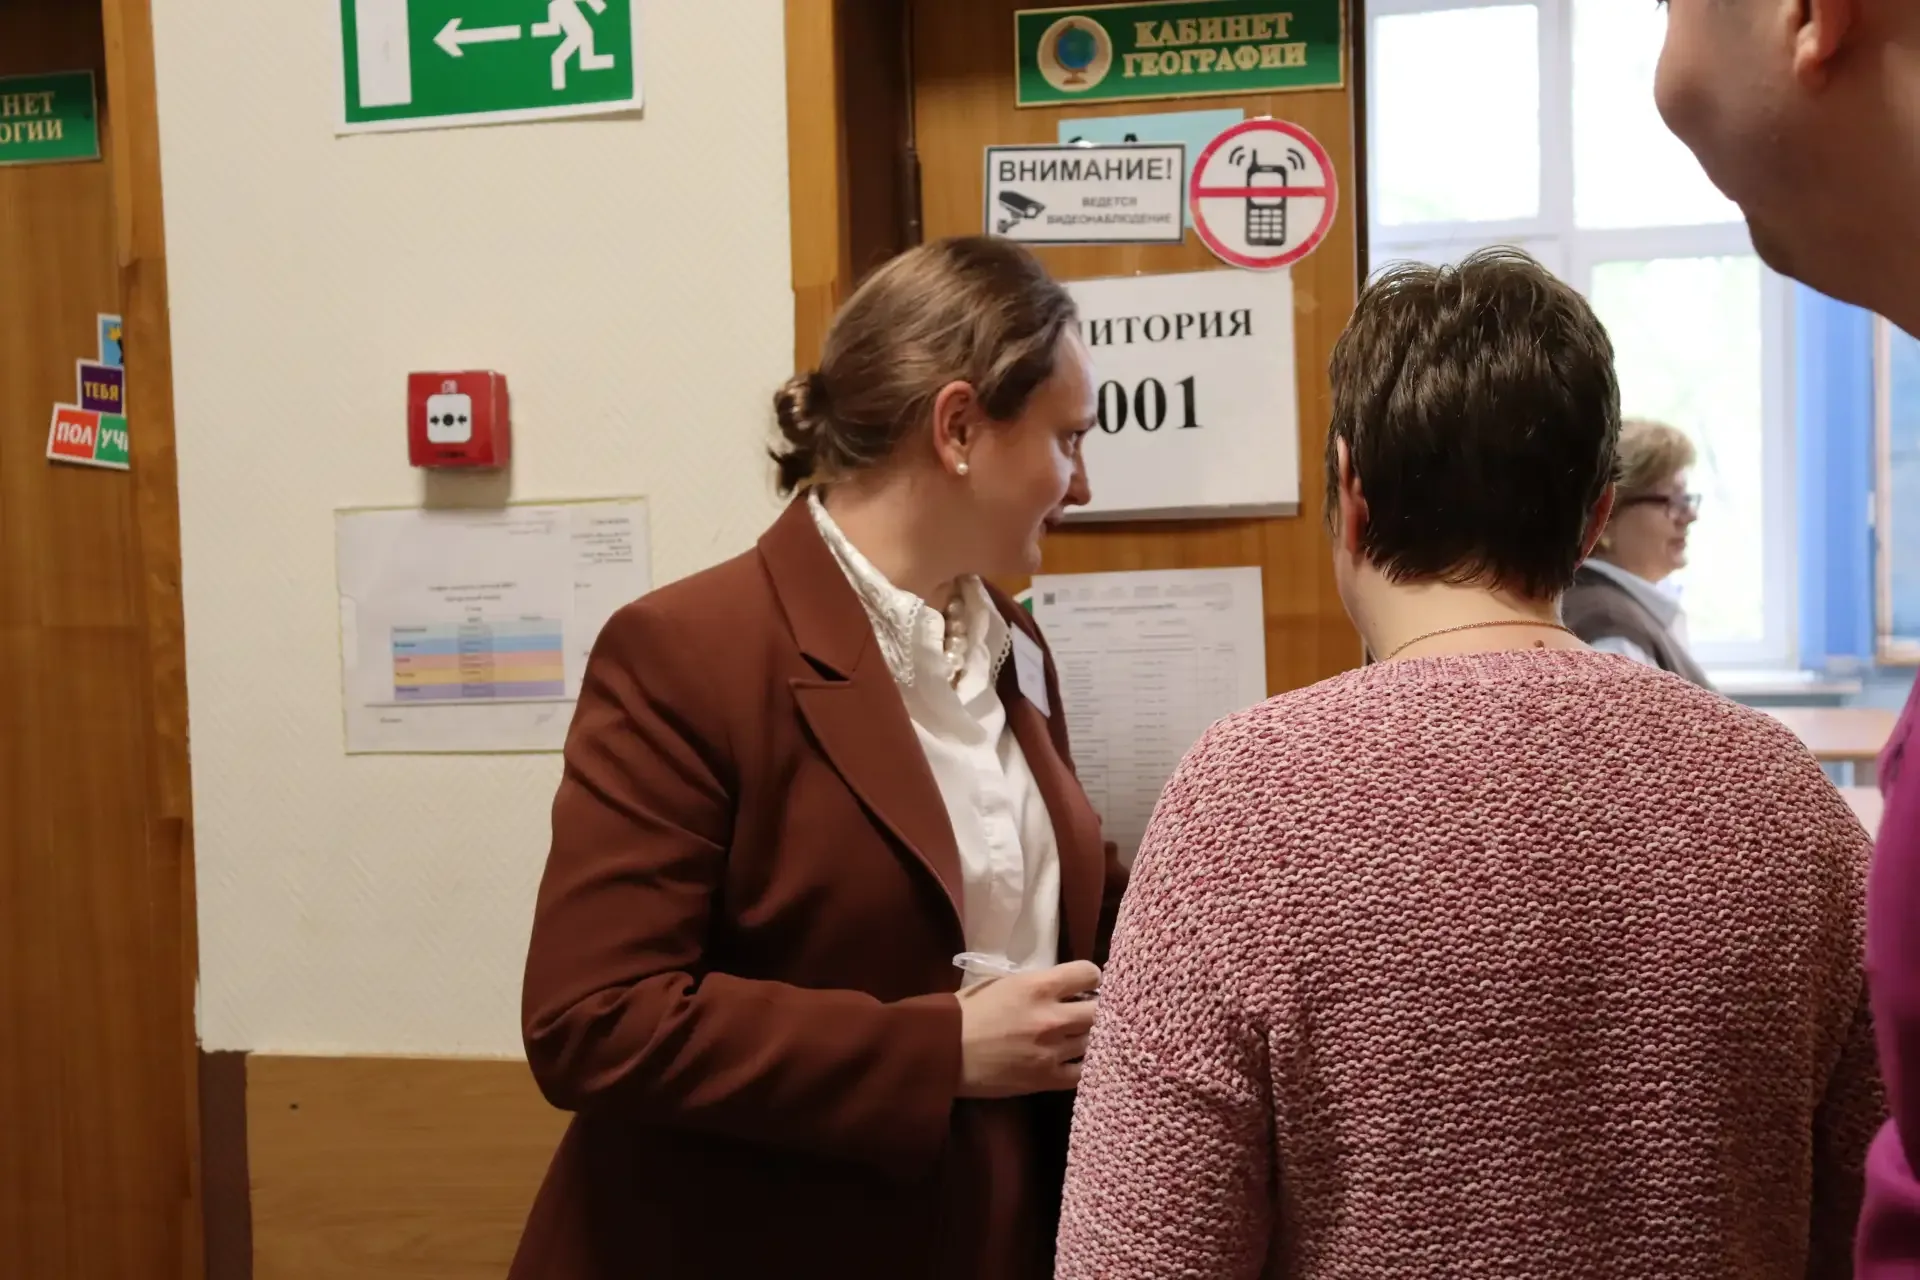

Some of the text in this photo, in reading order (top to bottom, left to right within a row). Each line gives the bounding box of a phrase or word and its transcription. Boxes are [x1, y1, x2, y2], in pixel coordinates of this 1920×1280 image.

[1134, 12, 1293, 48] КАБИНЕТ
[1122, 42, 1308, 78] ГЕОГРАФИИ
[1000, 158, 1172, 182] ВНИМАНИЕ!
[1082, 196, 1137, 208] ВЕДЕТСЯ
[1047, 212, 1172, 225] ВИДЕОНАБЛЮДЕНИЕ
[1077, 308, 1253, 347] ИТОРИЯ
[84, 381, 119, 401] ТЕБЯ
[1097, 374, 1203, 434] 001
